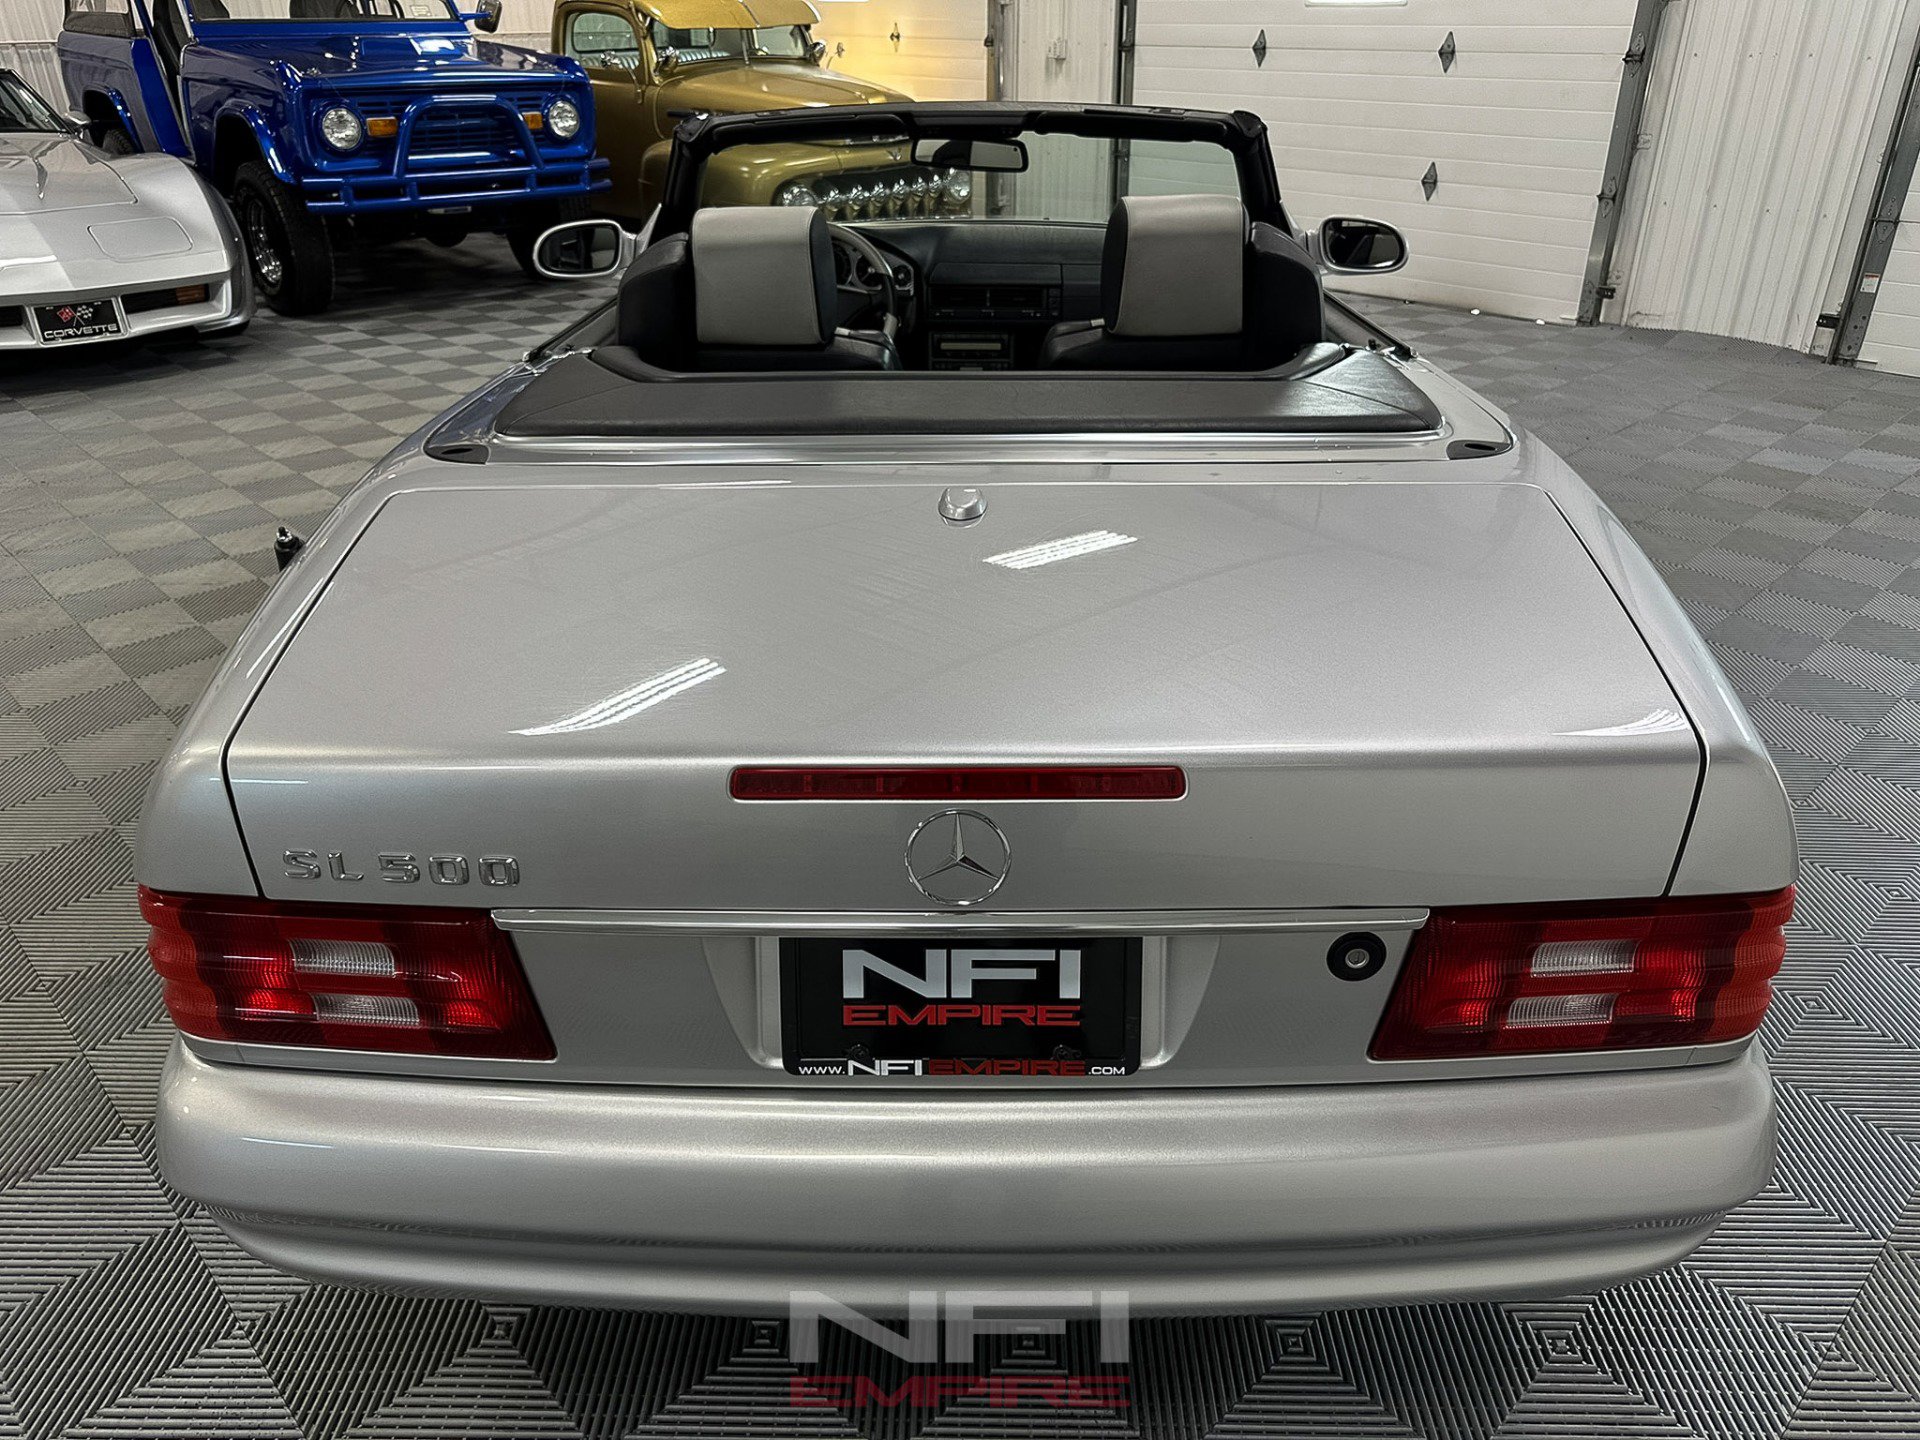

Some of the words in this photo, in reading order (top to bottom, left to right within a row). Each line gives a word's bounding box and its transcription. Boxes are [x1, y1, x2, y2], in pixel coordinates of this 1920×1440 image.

[44, 323, 118, 339] CORVETTE
[283, 850, 364, 881] SL
[378, 853, 520, 886] 500
[842, 949, 1081, 999] NFI
[842, 1005, 1081, 1026] EMPIRE
